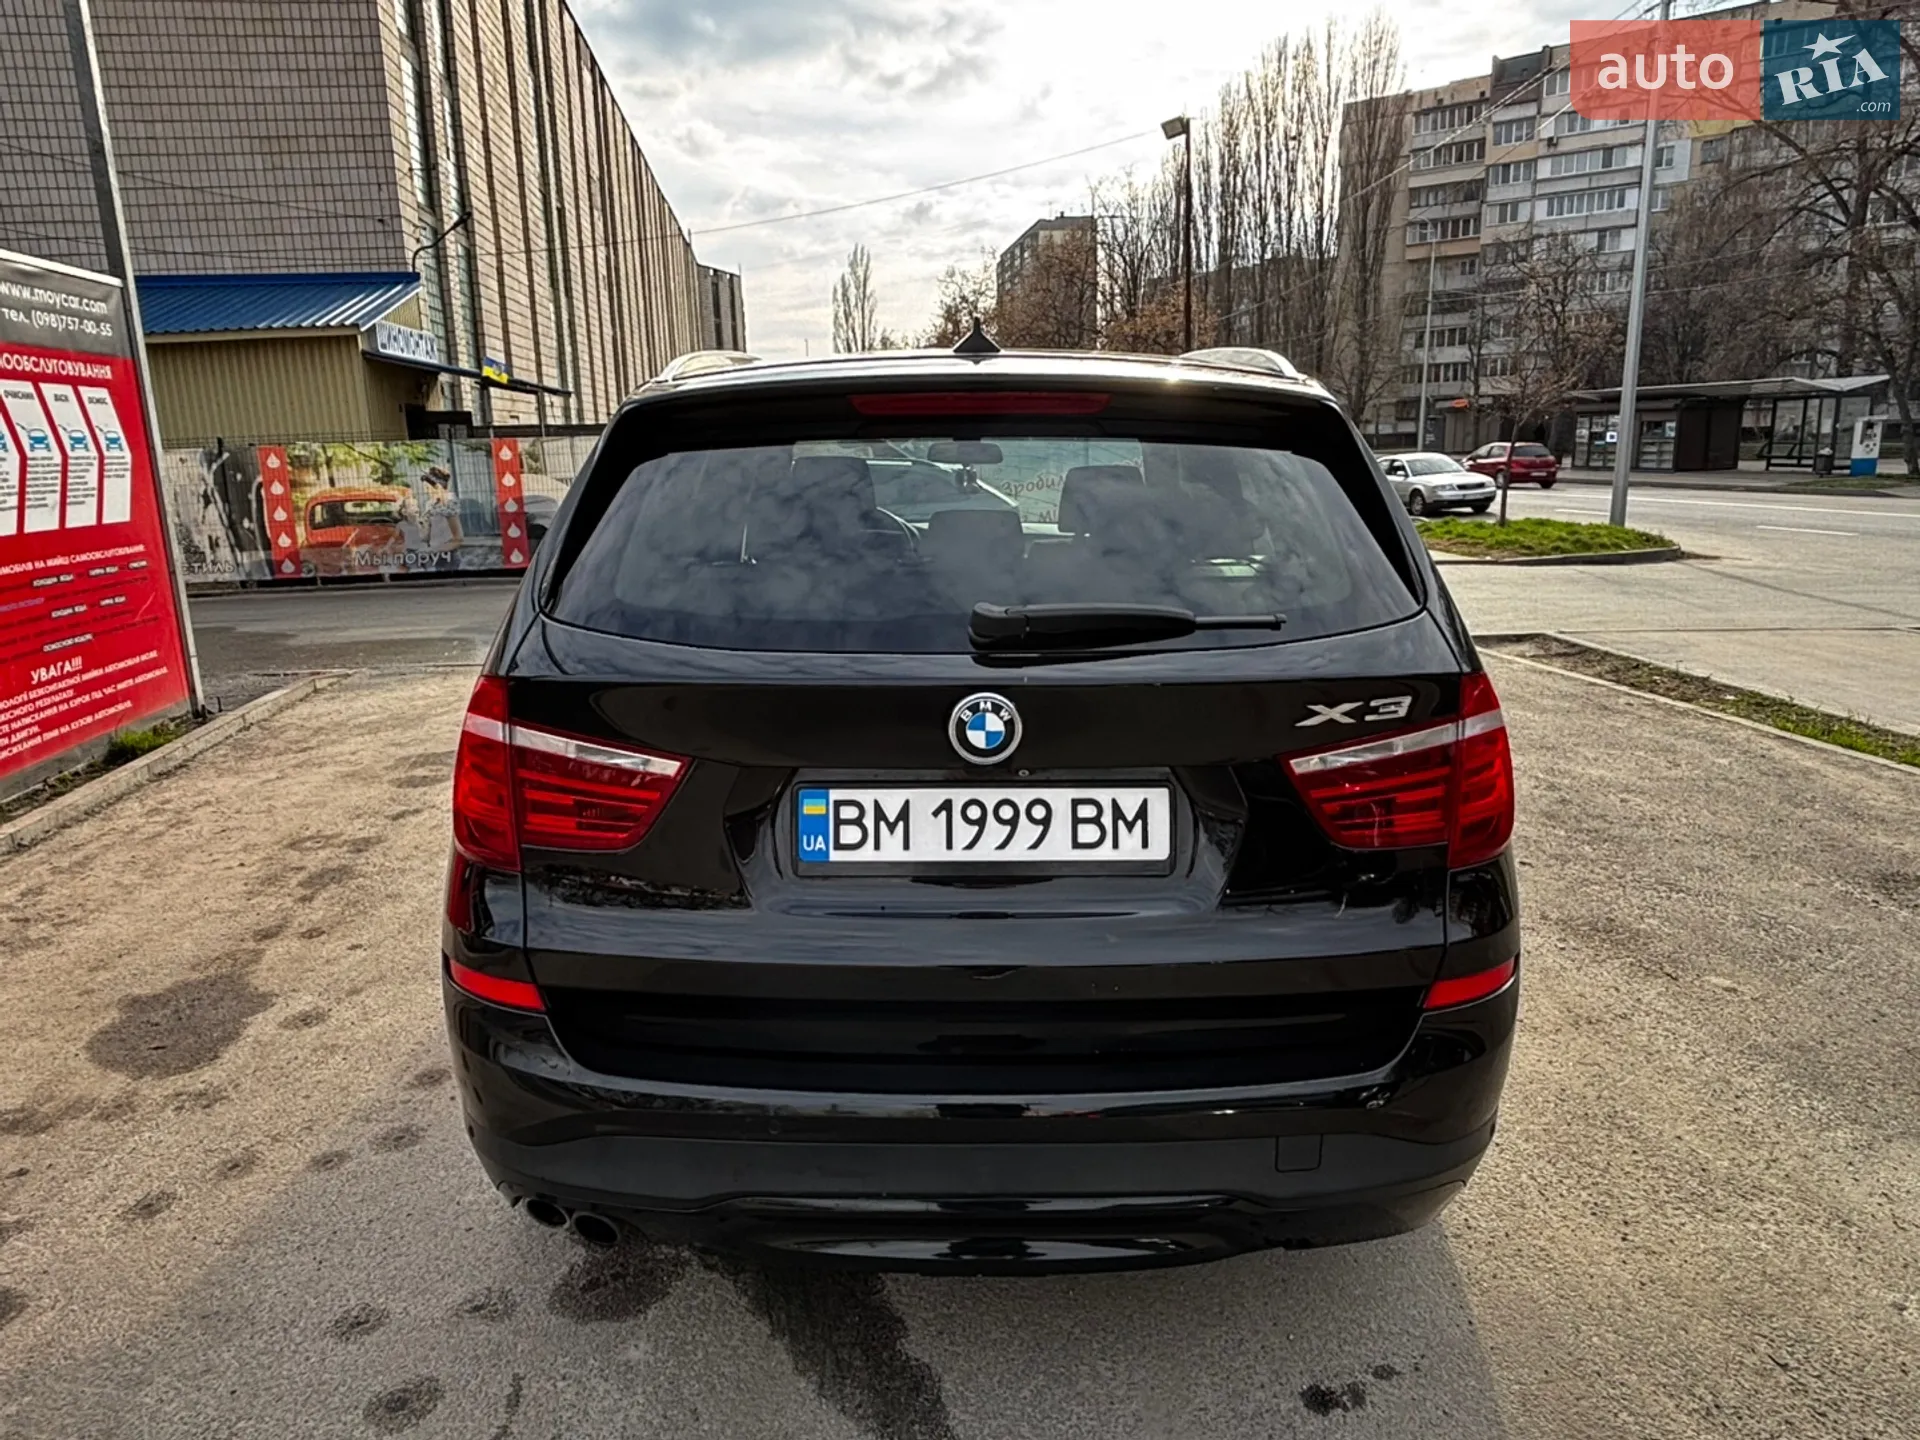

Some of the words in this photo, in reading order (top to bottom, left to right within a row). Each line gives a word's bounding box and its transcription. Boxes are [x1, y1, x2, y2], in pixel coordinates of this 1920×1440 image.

[0, 281, 108, 314] www.moycar.com
[30, 655, 83, 684] УВАГА!!!
[960, 701, 1012, 722] BMW
[1294, 695, 1412, 727] X3
[803, 835, 826, 852] UA
[833, 798, 910, 852] BM
[931, 798, 1053, 851] 1999
[1071, 797, 1149, 850] BM
